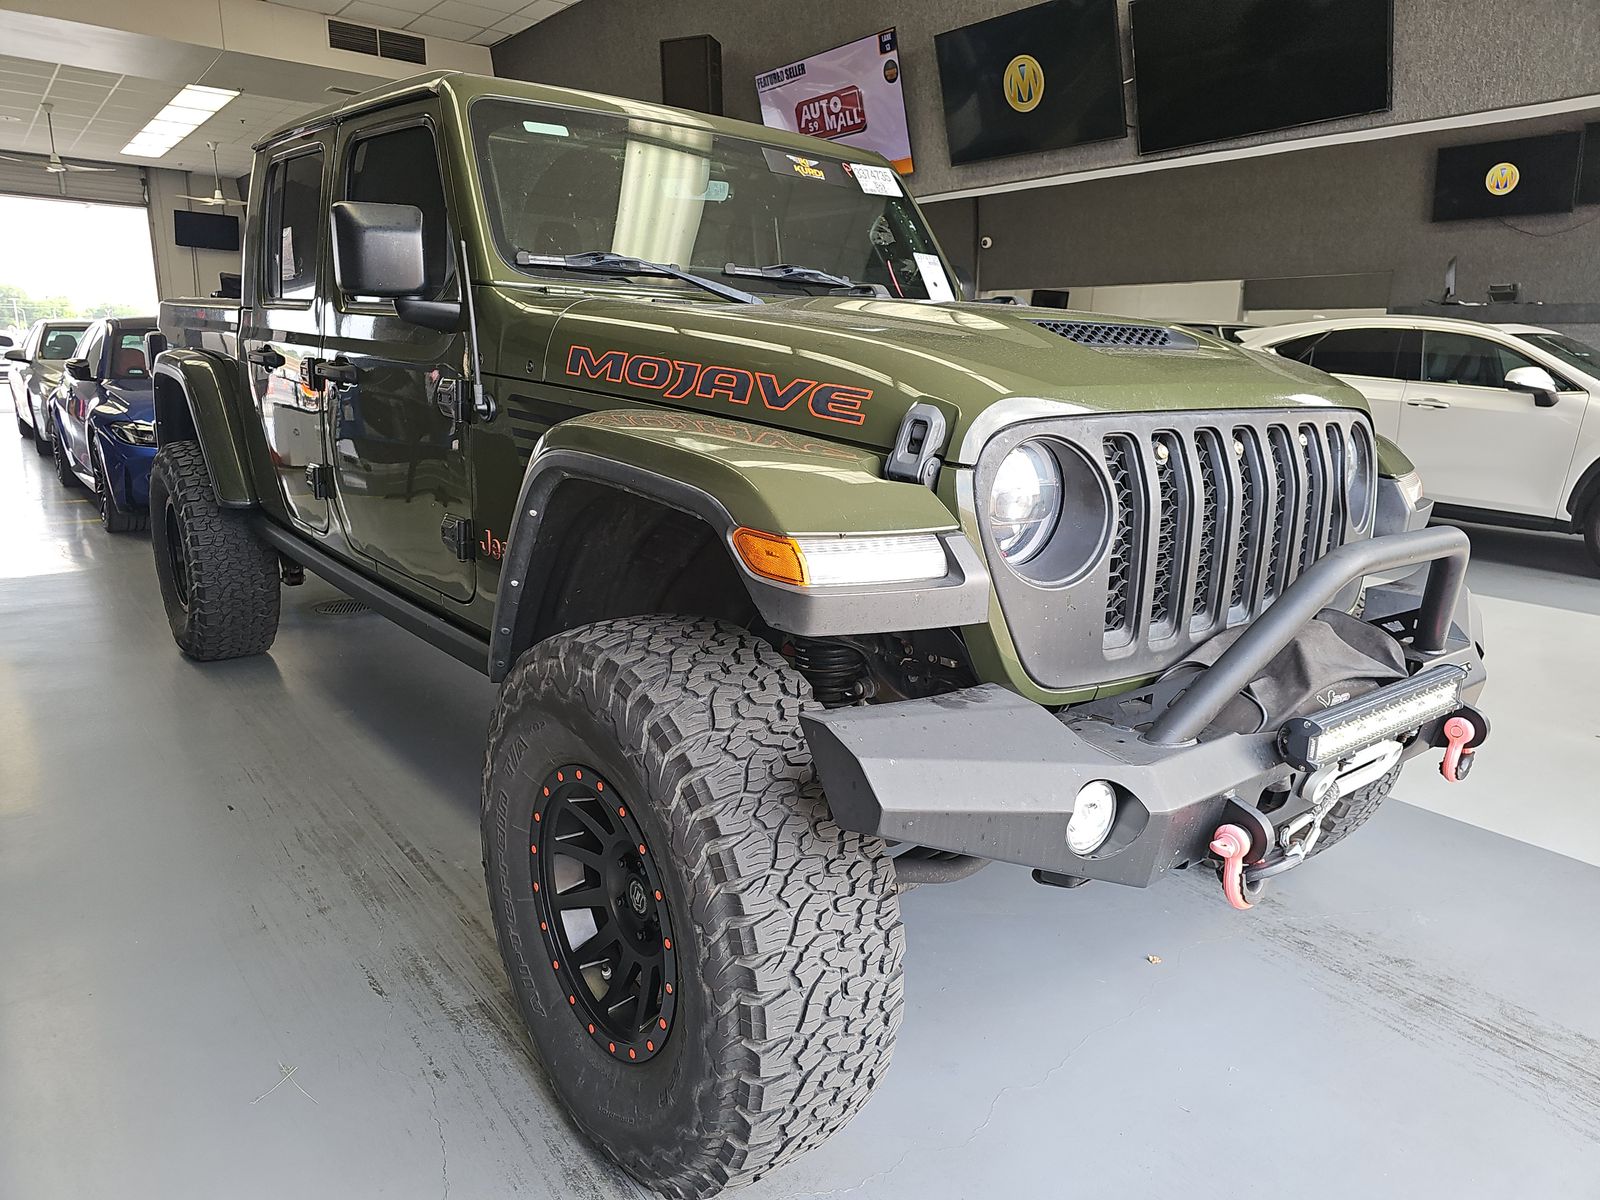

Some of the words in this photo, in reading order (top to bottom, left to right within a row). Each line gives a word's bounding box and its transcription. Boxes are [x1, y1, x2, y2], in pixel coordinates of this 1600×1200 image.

[756, 70, 785, 89] FEATURED
[785, 63, 806, 80] SELLER
[801, 96, 841, 128] AUTO
[825, 109, 862, 132] MALL
[808, 121, 819, 132] 59
[853, 167, 892, 182] 3374735
[566, 346, 873, 425] MOJAVE
